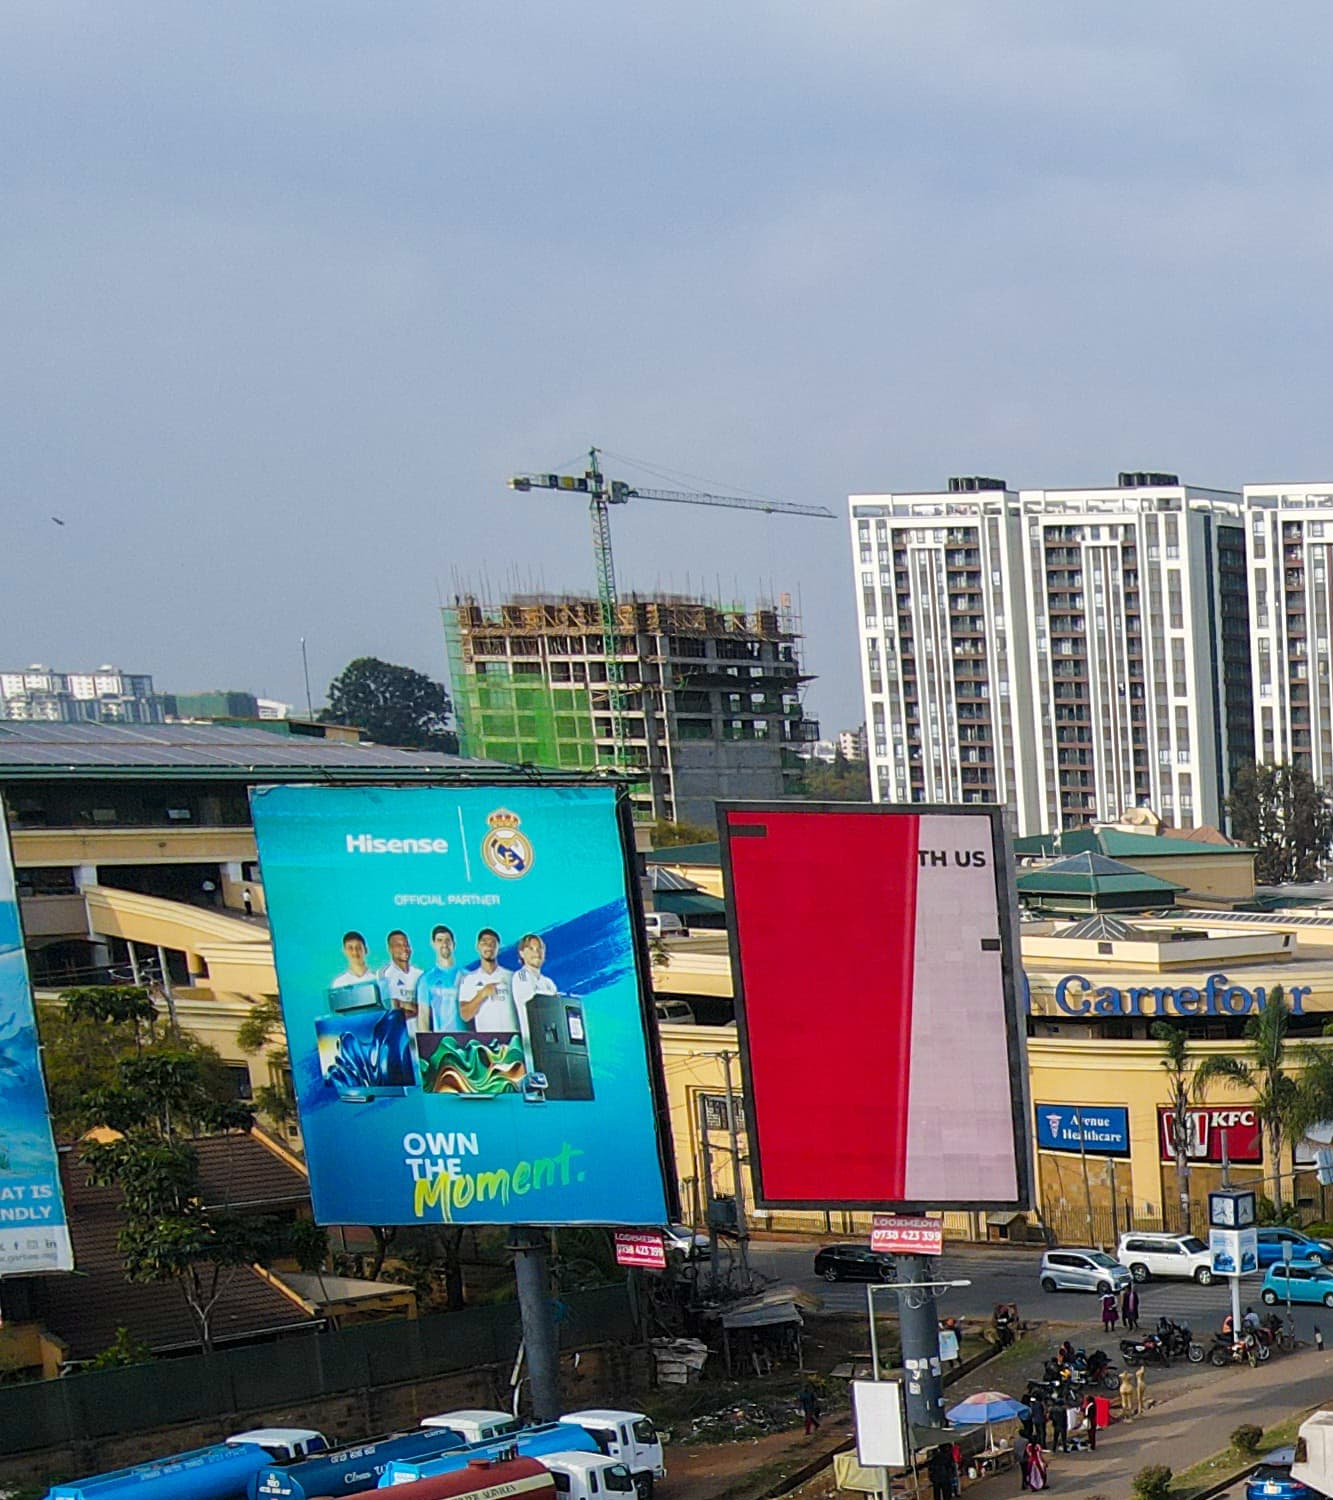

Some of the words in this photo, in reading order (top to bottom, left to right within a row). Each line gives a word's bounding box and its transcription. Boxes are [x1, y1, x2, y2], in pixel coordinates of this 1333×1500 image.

[346, 833, 448, 853] Hisense
[918, 850, 947, 867] TH
[955, 850, 986, 867] US
[394, 894, 444, 906] OFFICIAL
[449, 894, 500, 906] PARTNER
[1211, 1111, 1254, 1127] KFC
[403, 1133, 479, 1155] OWN
[405, 1158, 461, 1181] THE
[30, 1184, 53, 1198] IS
